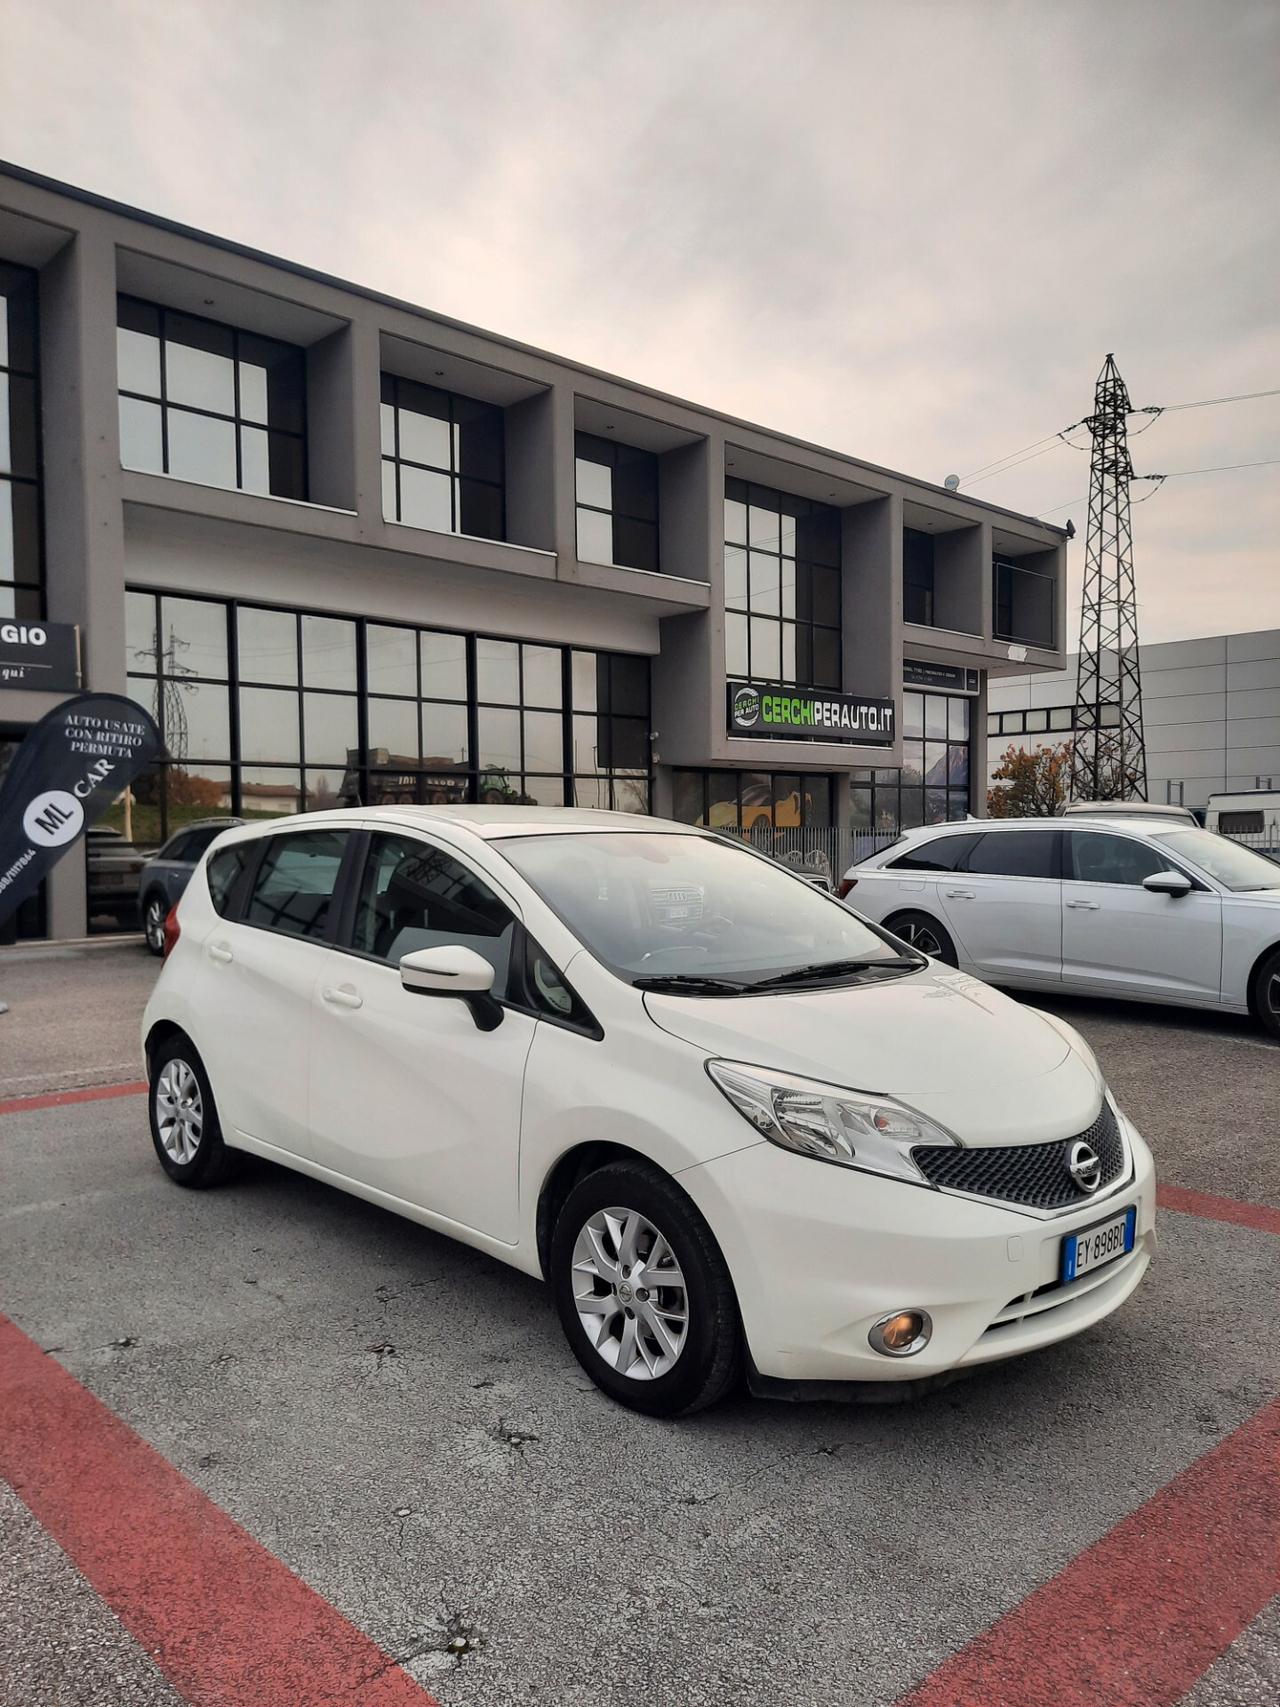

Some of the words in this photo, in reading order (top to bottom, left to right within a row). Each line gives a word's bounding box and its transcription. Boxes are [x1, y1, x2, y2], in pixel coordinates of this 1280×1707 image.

[1, 624, 47, 646] GIO
[2, 666, 25, 680] qui
[762, 695, 892, 731] CERCHIPERAUTO.IT
[65, 714, 102, 728] AUTO
[104, 719, 146, 736] USATE
[65, 727, 93, 740] CON
[96, 731, 143, 747] RITIRO
[70, 741, 133, 758] PERMUTA
[34, 803, 74, 836] ML
[74, 758, 115, 798] CAR
[1077, 1238, 1091, 1268] EY
